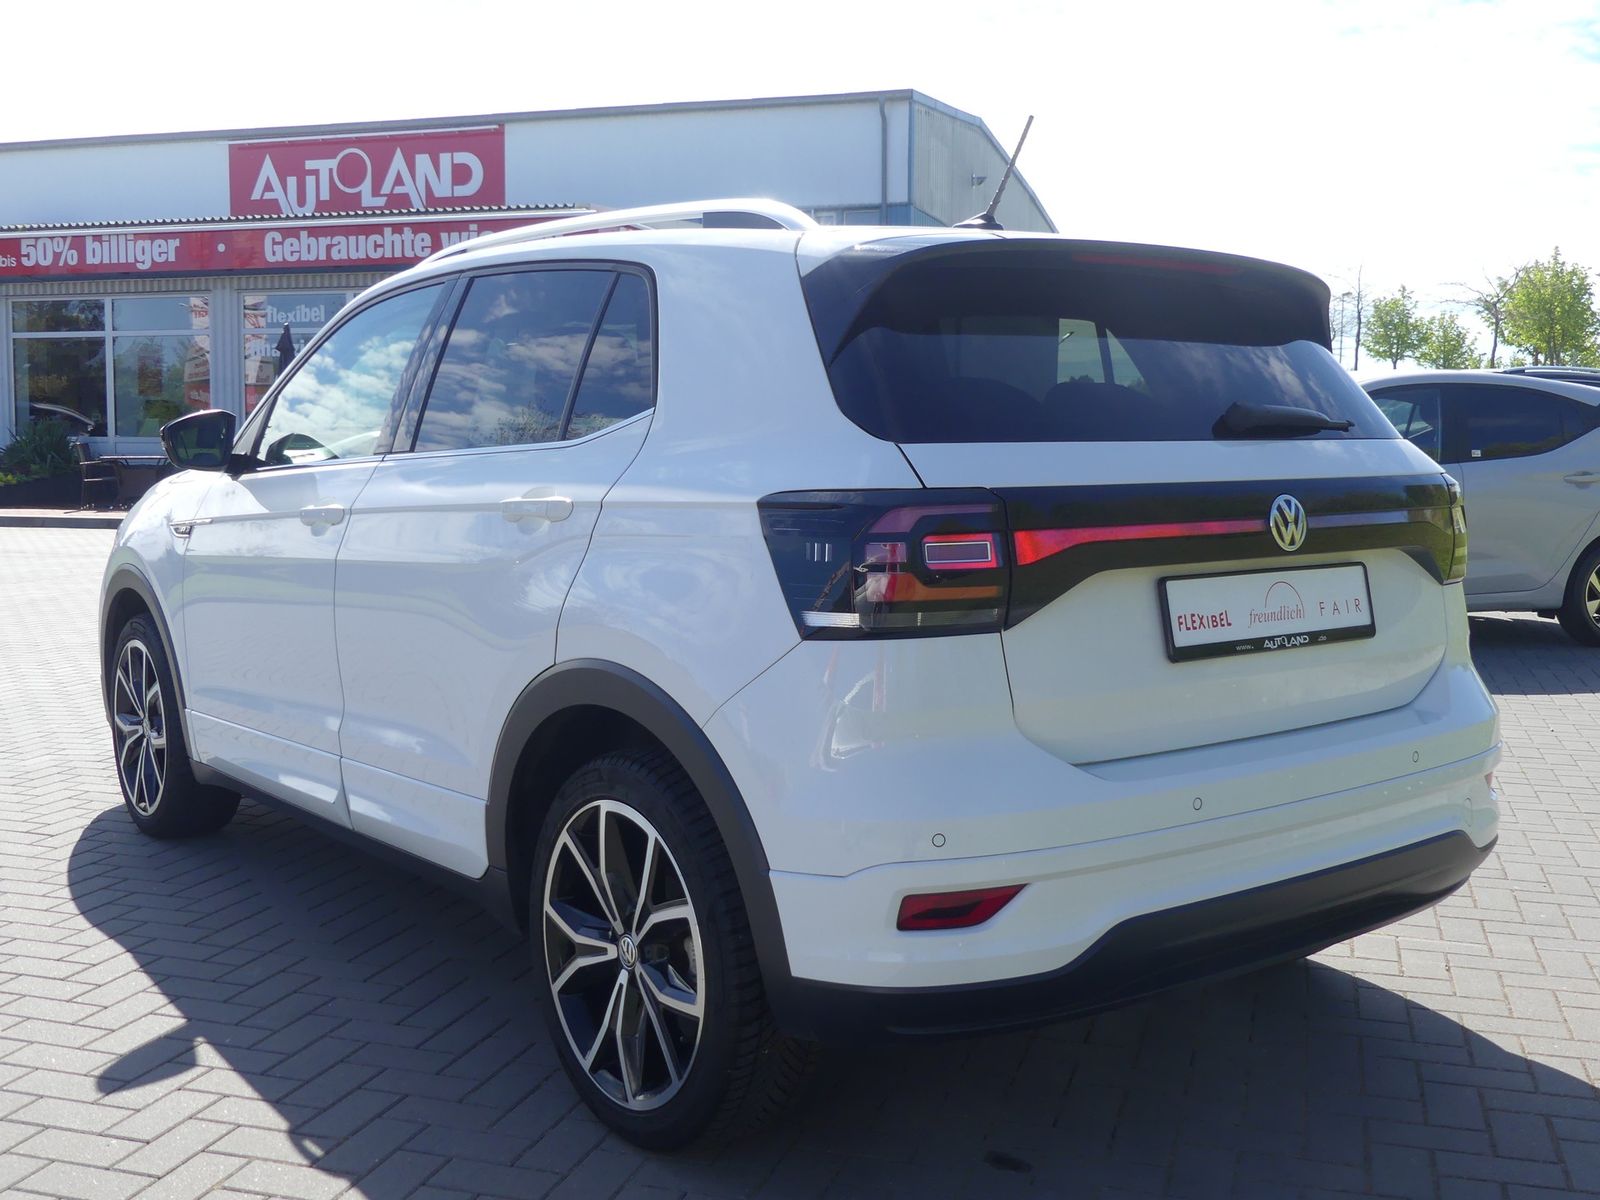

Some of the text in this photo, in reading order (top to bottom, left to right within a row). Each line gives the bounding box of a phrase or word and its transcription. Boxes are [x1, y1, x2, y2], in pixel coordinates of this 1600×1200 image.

[0, 224, 496, 270] bis 50% billiger Gebrauchte wi
[266, 304, 326, 323] flexibel
[1177, 598, 1363, 632] FLEXIBEL freundlich FAIR
